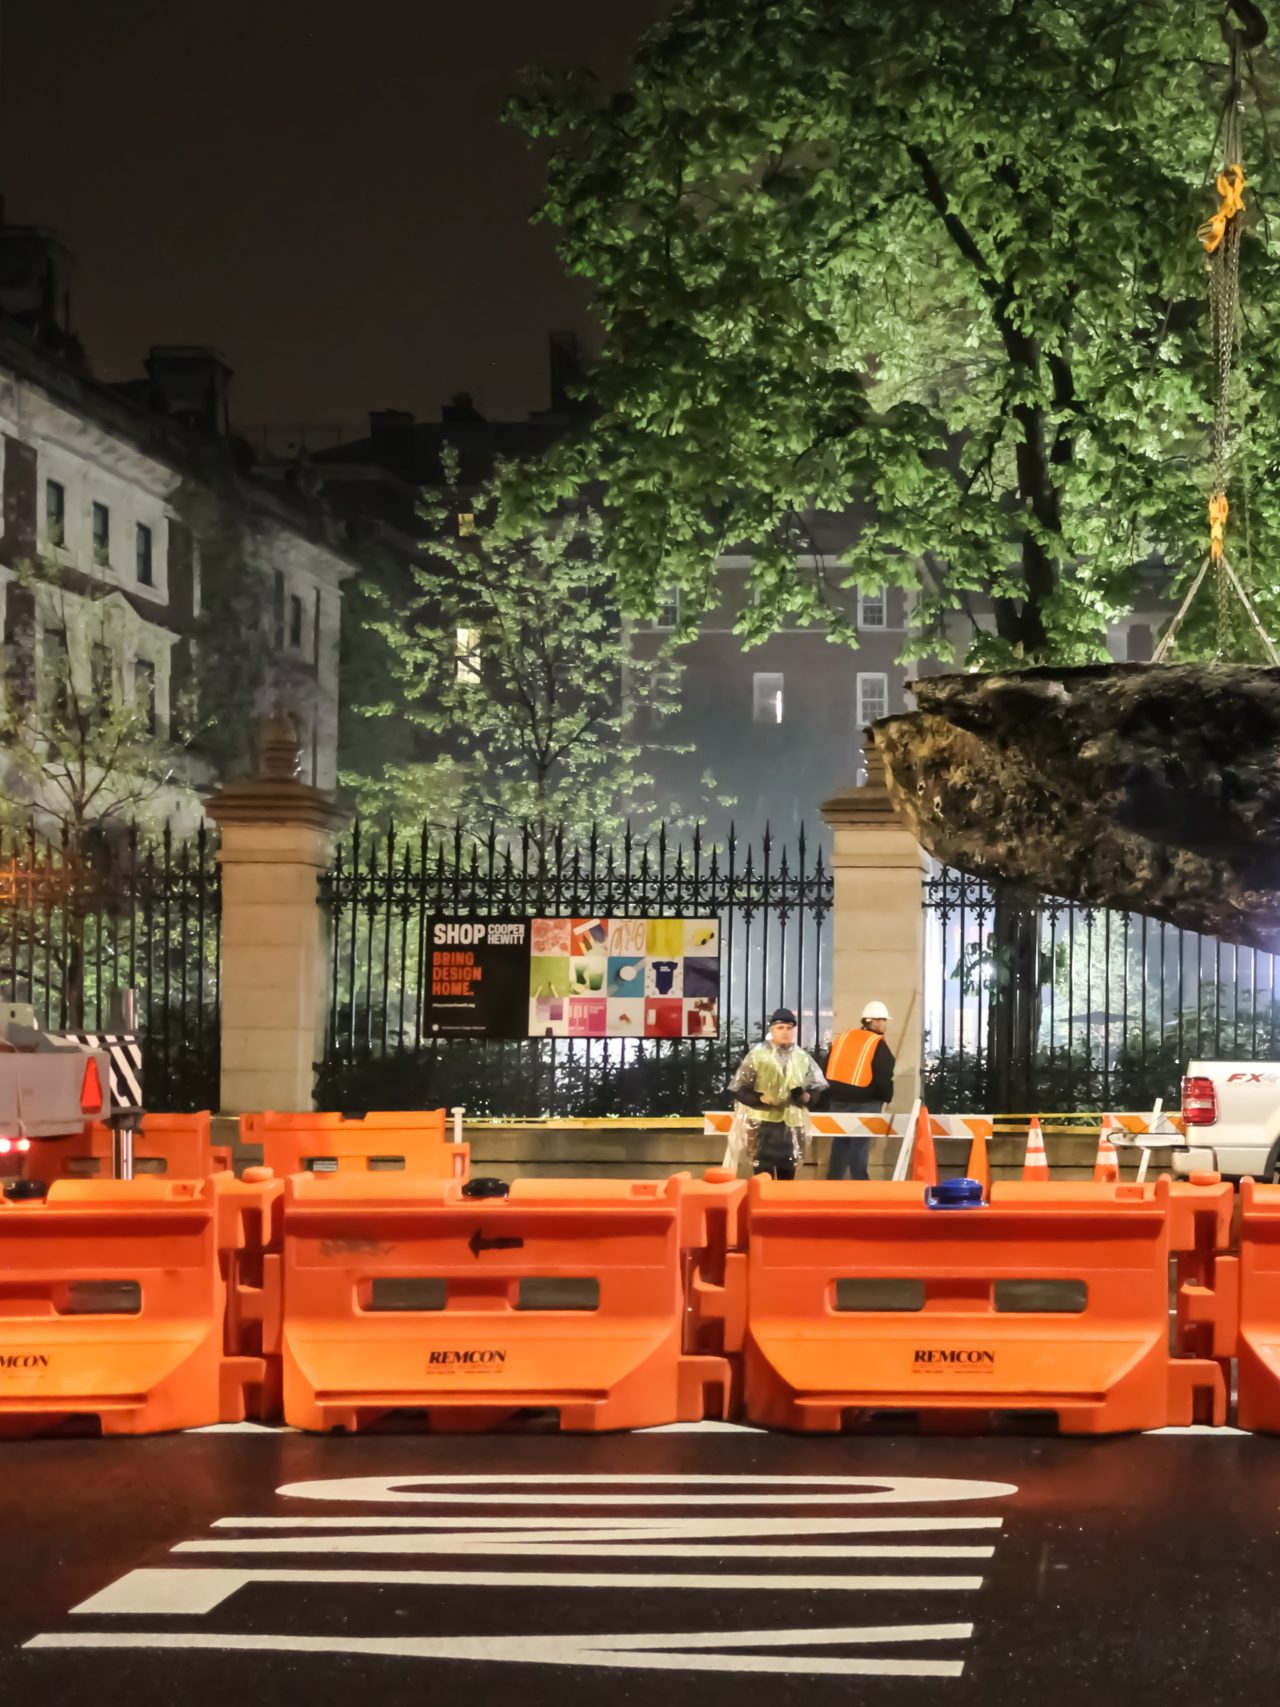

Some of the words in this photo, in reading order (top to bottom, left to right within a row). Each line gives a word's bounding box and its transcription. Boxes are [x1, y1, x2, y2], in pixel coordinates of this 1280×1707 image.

[434, 923, 485, 945] SHOP
[487, 924, 525, 934] COOPER
[487, 934, 525, 945] HEWITT
[432, 951, 474, 966] BRING
[432, 967, 482, 981] DESIGN
[432, 982, 474, 996] HOME.
[428, 1350, 506, 1364] REMCON
[913, 1350, 995, 1363] REMCON
